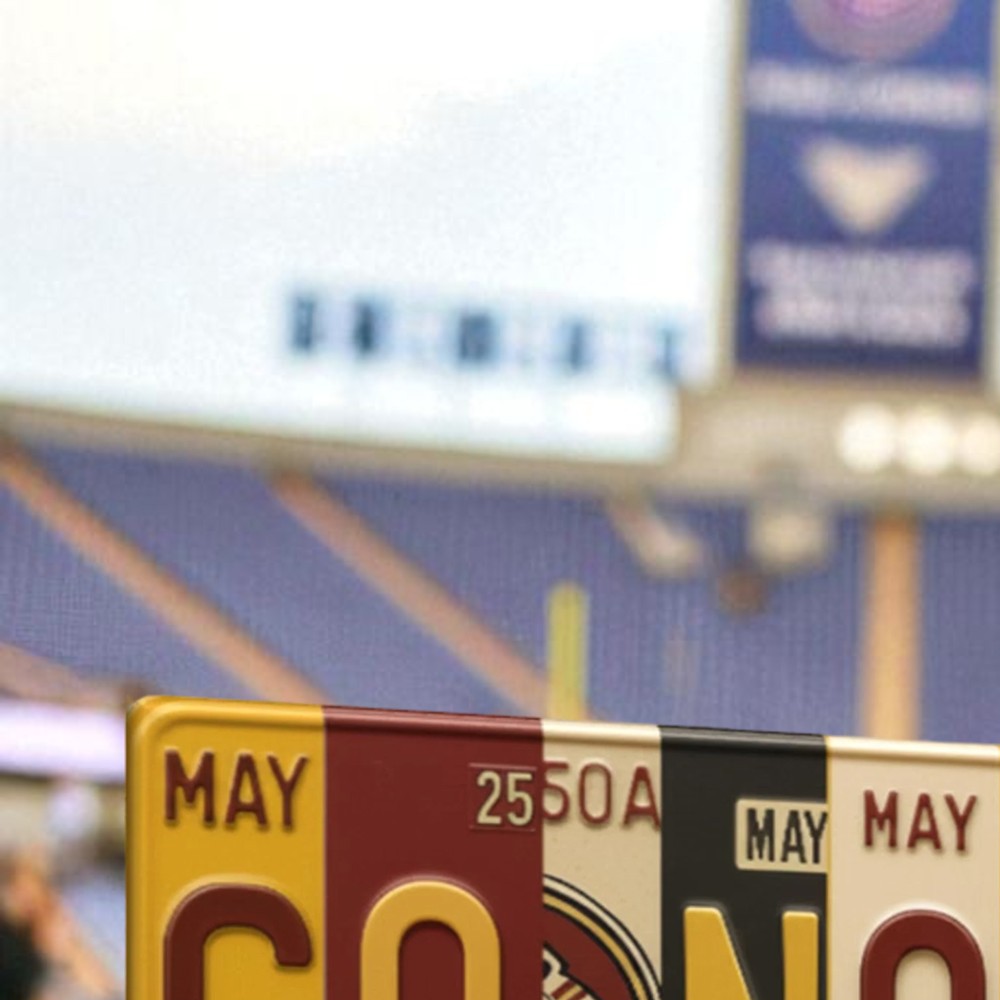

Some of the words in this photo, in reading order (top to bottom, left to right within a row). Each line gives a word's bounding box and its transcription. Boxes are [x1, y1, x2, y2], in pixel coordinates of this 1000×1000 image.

[164, 749, 310, 832] MAY
[476, 769, 534, 827] 25
[862, 789, 978, 853] MAY
[746, 807, 828, 865] MAY
